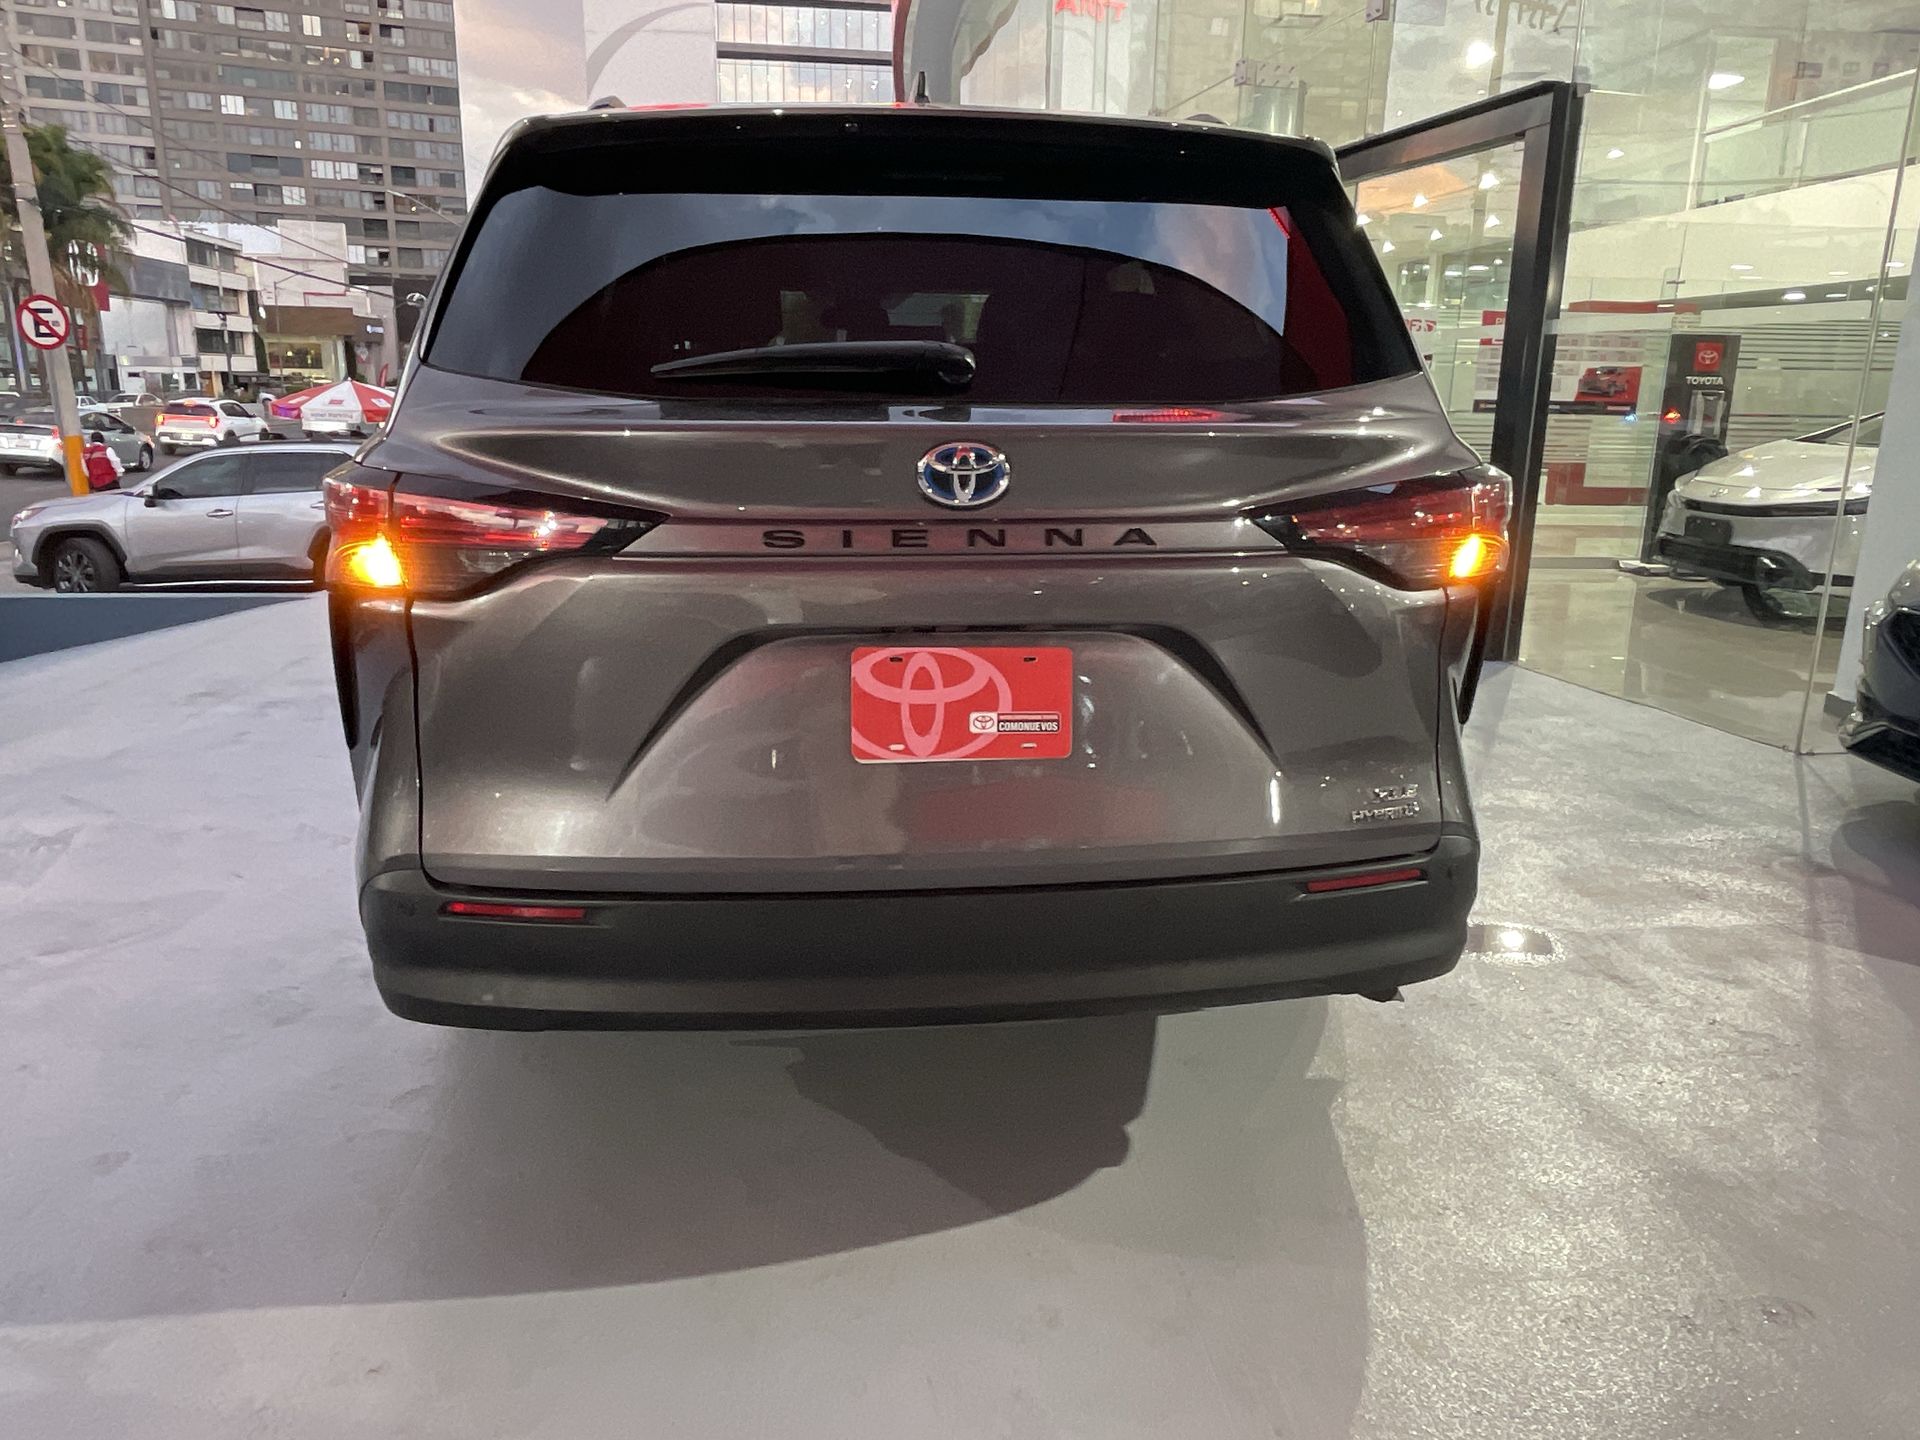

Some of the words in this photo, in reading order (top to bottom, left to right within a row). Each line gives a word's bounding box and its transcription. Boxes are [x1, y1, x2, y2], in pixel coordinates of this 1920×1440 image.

[1685, 376, 1724, 386] TOYOTA
[762, 527, 1157, 549] SIENNA
[999, 721, 1059, 731] COMONUEVOS
